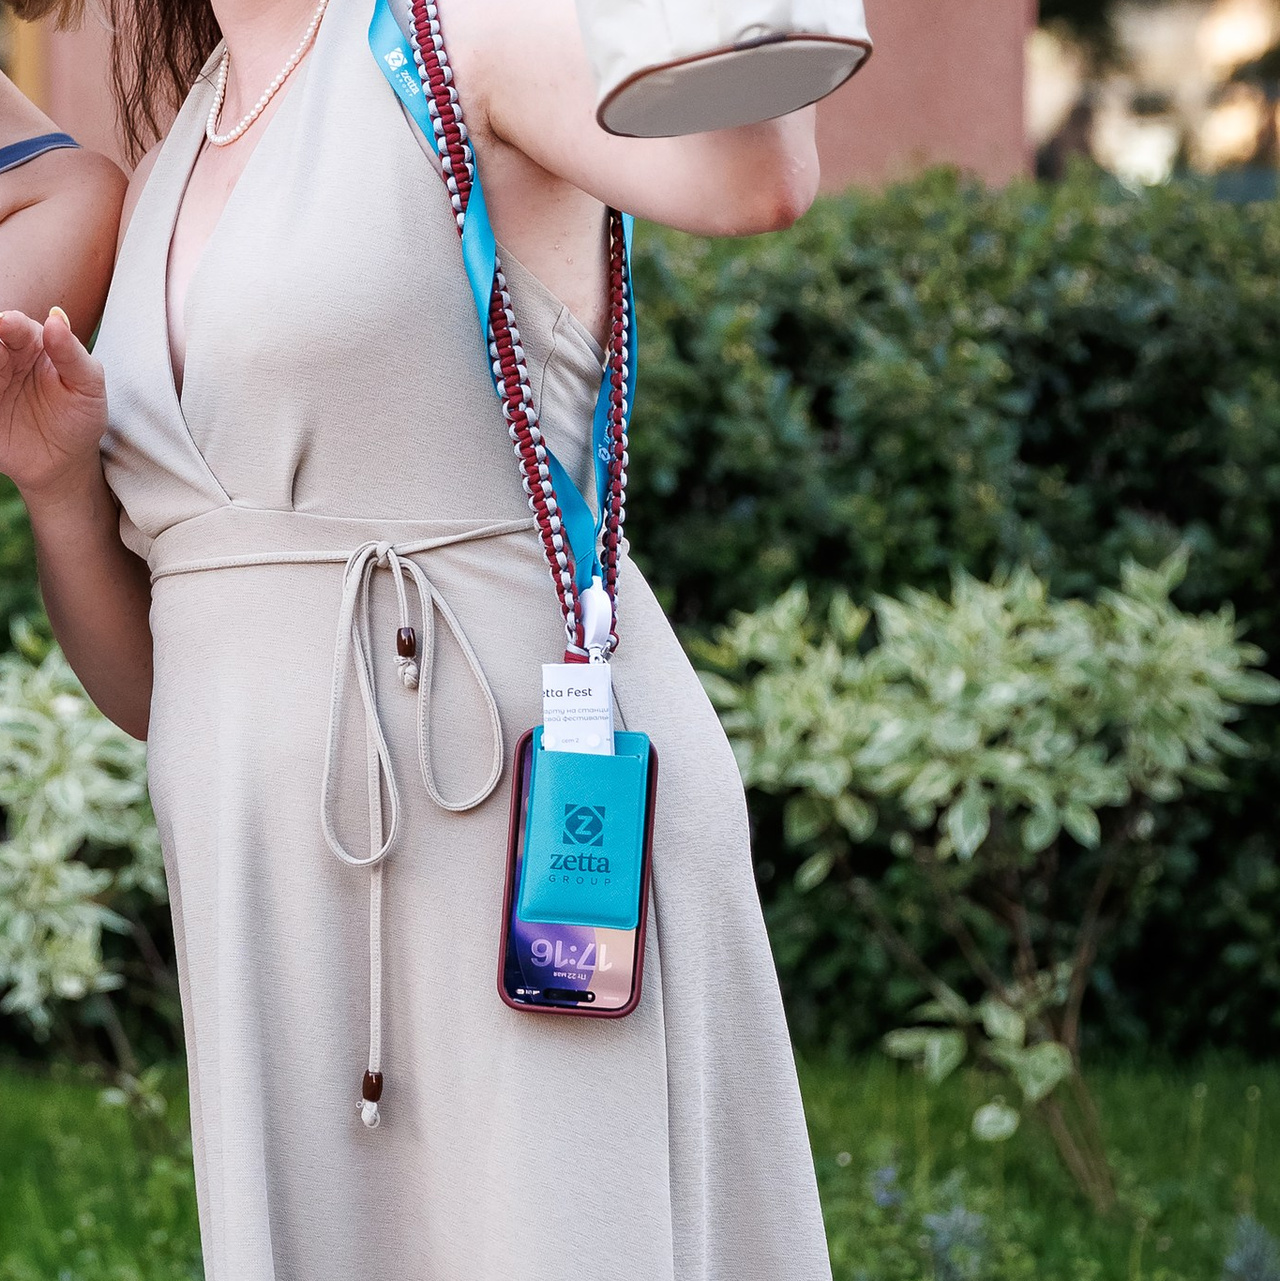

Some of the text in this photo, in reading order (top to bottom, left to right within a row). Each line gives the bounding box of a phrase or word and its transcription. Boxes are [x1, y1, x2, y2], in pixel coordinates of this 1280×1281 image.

[400, 69, 420, 95] zetta
[567, 687, 593, 698] Fest
[549, 852, 611, 874] zetta
[548, 874, 612, 887] GROUP
[530, 938, 613, 972] 17:16
[553, 971, 567, 979] мая
[567, 972, 577, 980] 22
